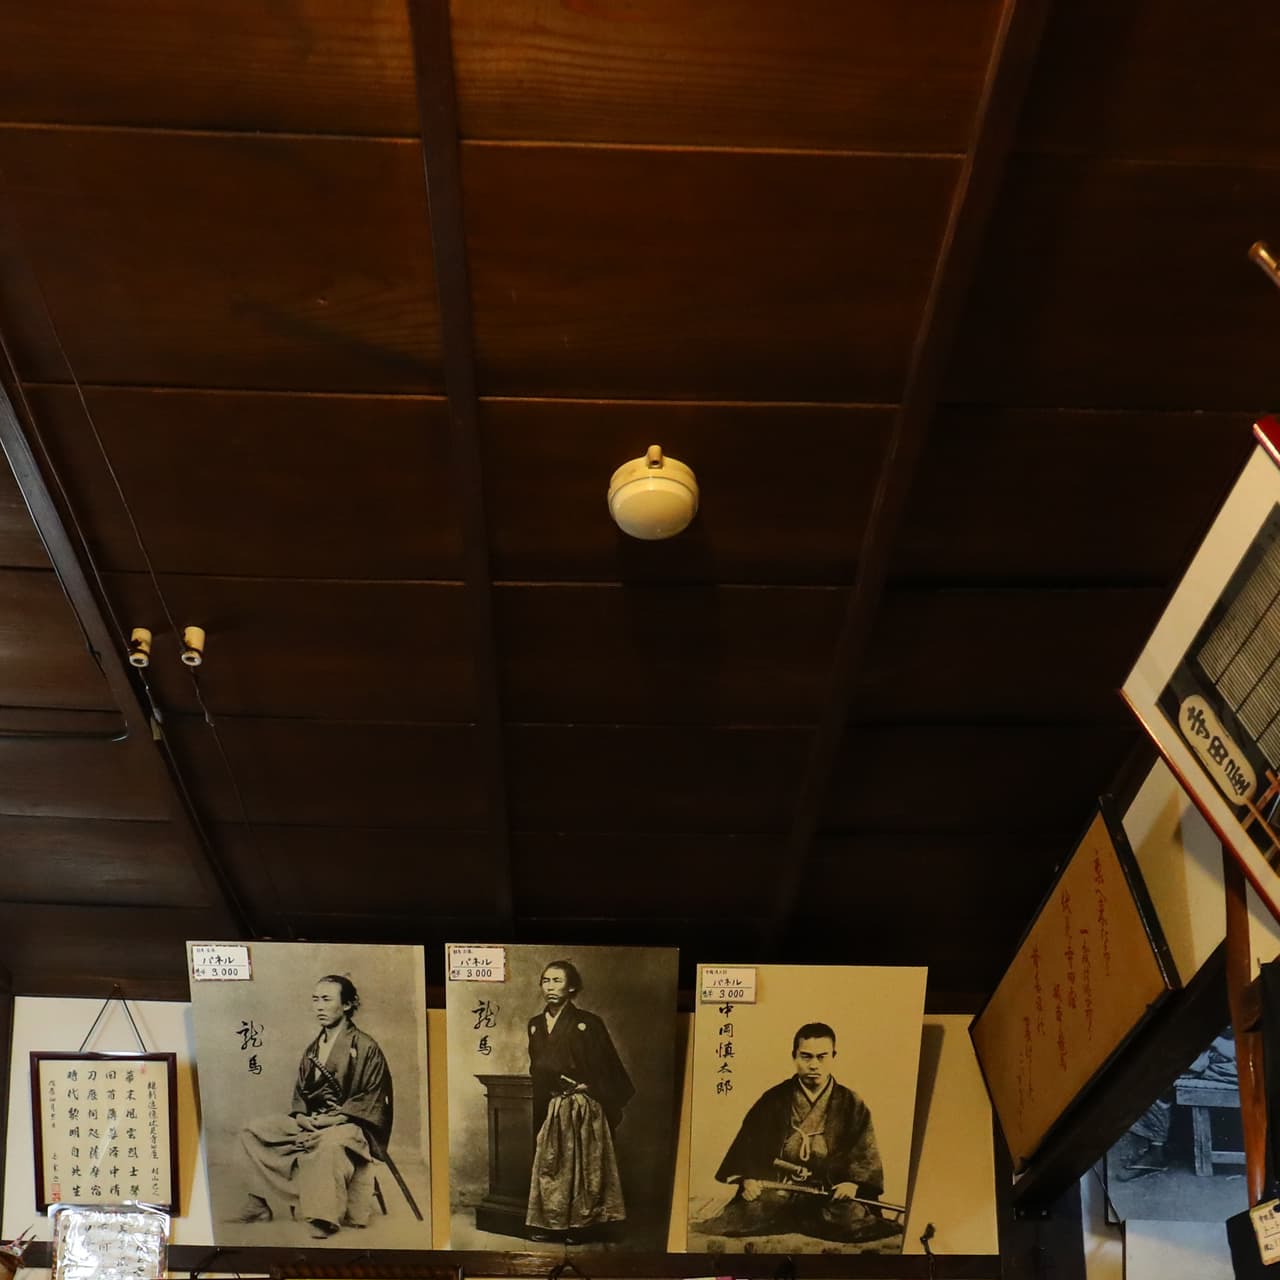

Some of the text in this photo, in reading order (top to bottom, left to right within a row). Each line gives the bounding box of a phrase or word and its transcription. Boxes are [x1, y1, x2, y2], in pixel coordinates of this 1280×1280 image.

[201, 954, 236, 966] パネル
[460, 958, 493, 967] パネル
[712, 978, 743, 988] パネル
[471, 999, 500, 1057] 龍馬
[235, 1019, 265, 1077] 龍馬
[715, 1002, 737, 1096] 中岡慎太郎
